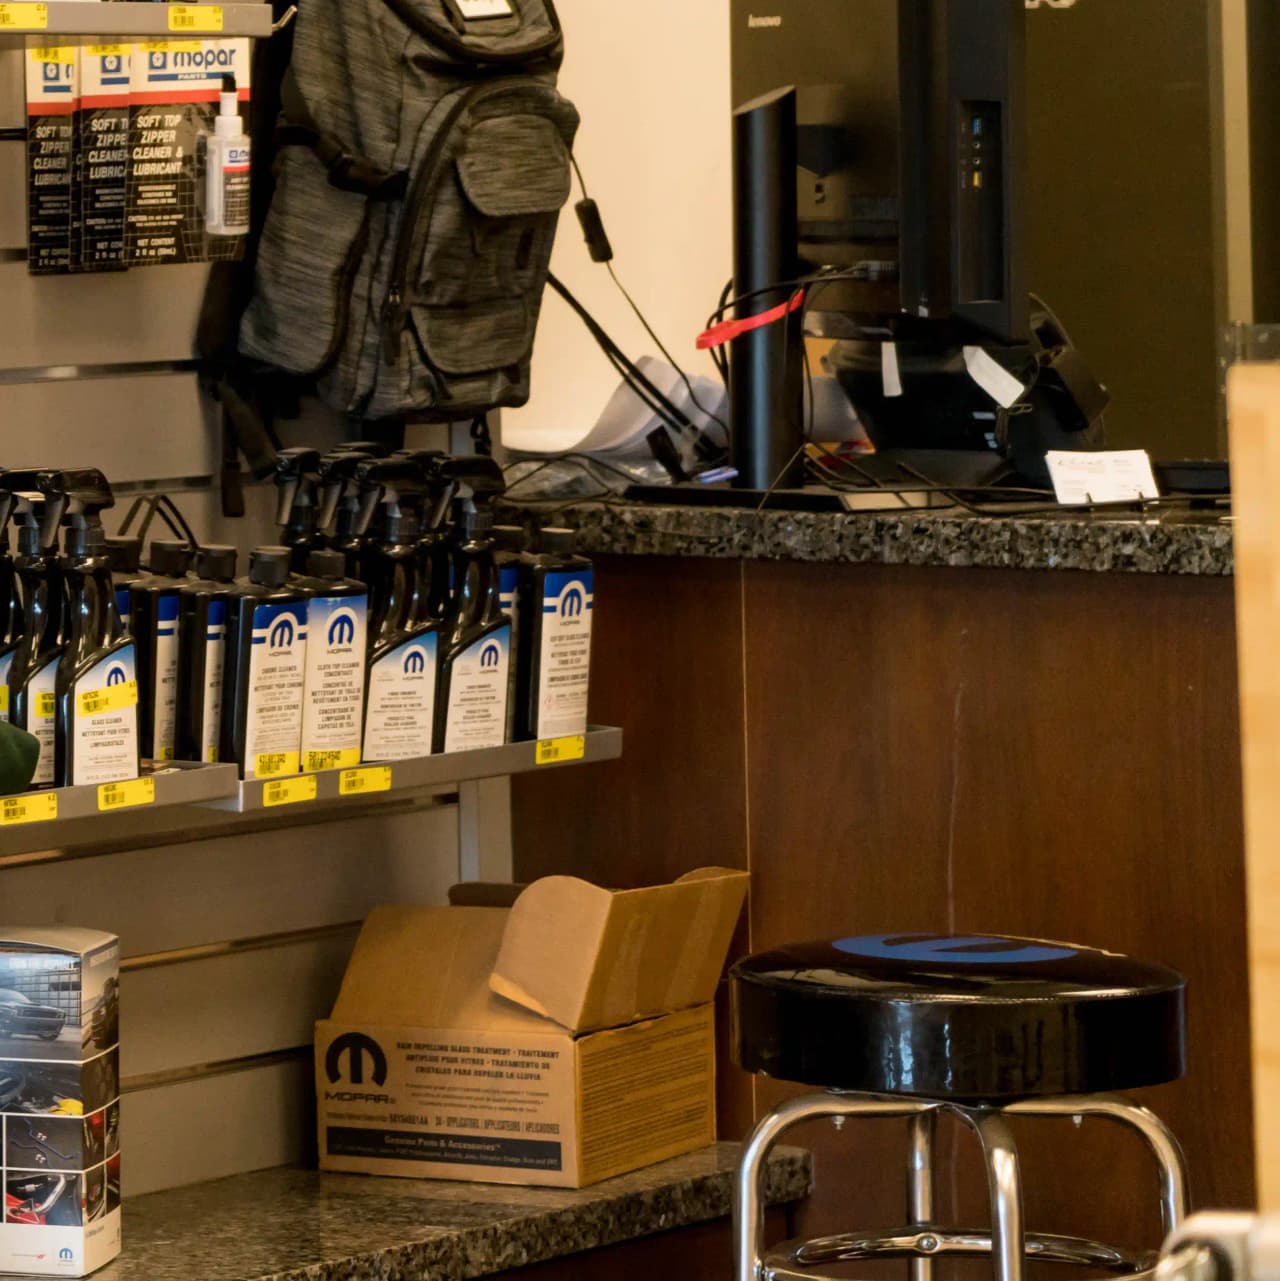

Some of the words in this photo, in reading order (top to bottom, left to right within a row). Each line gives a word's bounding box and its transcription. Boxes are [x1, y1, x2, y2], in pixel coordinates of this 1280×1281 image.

[92, 119, 115, 132] SOFT
[137, 115, 161, 128] SOFT
[164, 115, 182, 126] TOP
[141, 130, 176, 143] ZIPPER
[133, 147, 171, 159] CLEANER
[133, 162, 183, 176] LUBRICANT
[325, 1091, 389, 1104] MOPAR
